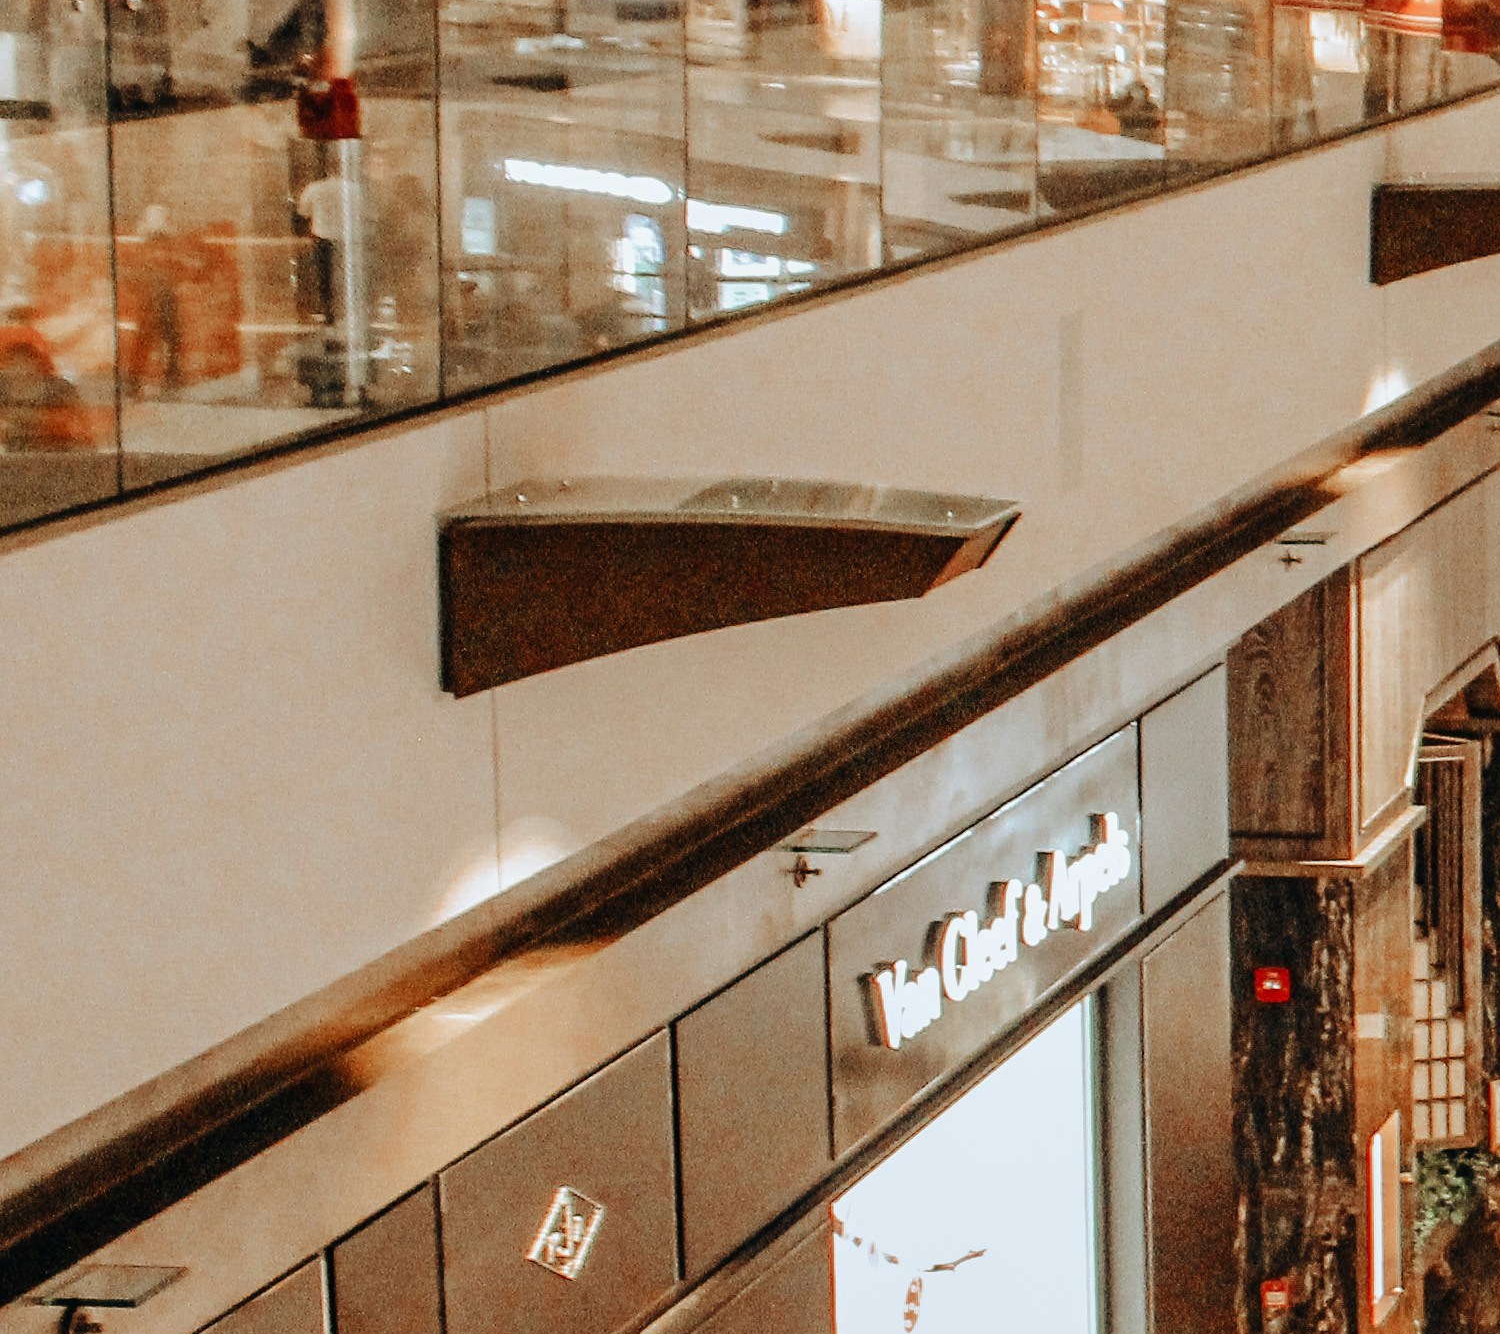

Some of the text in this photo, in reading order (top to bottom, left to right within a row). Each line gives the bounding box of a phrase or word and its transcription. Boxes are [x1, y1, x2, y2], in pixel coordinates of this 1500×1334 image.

[874, 959, 942, 1050] Van
[939, 878, 1023, 1002] Cleef
[1046, 811, 1131, 932] Arpels
